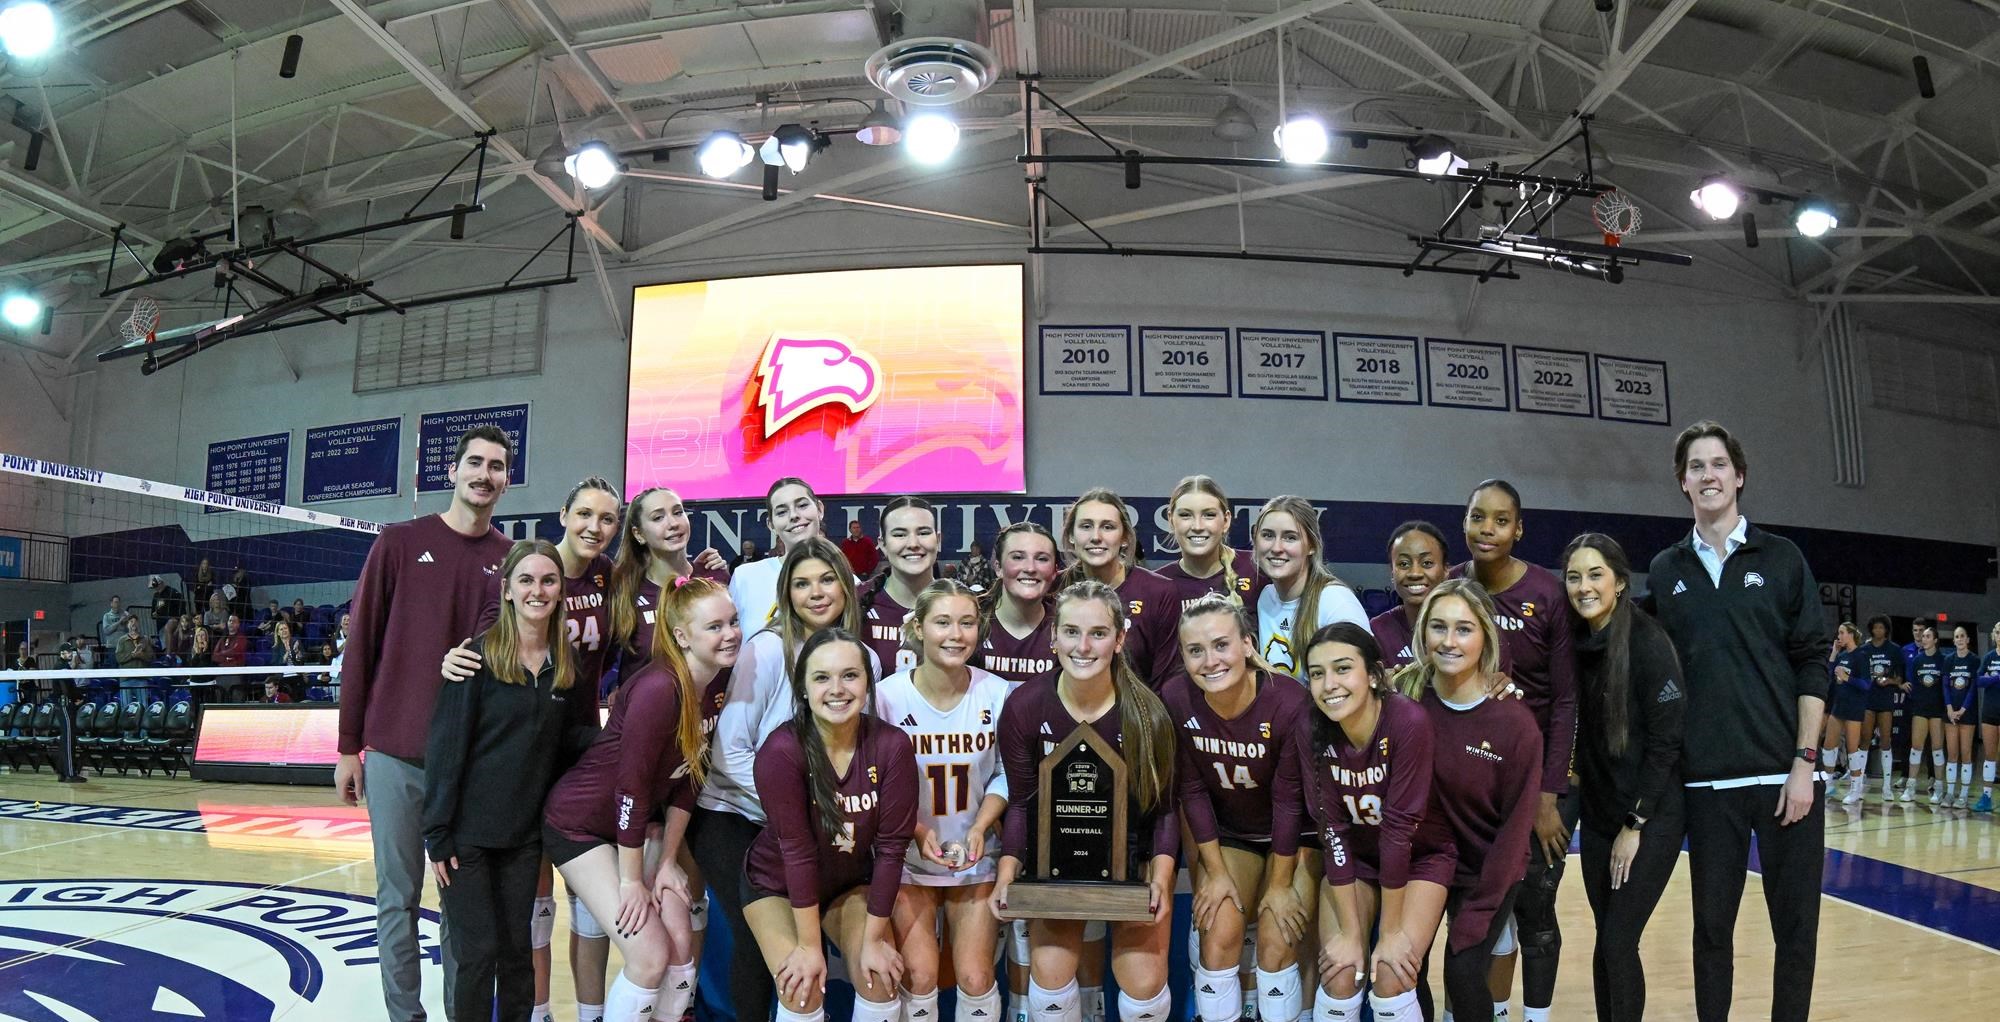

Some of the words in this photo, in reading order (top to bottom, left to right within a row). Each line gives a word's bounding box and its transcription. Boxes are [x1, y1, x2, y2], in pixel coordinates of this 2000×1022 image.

[1063, 349, 1109, 363] 2010
[1162, 351, 1209, 365] 2016
[1260, 353, 1305, 368] 2017
[1357, 358, 1400, 373] 2018
[1447, 363, 1488, 379] 2020
[1534, 370, 1573, 386] 2022
[1616, 379, 1652, 395] 2023
[474, 409, 525, 420] UNIVERSITY
[328, 429, 351, 437] POINT
[353, 423, 398, 434] UNIVERSITY
[227, 444, 246, 452] POINT
[248, 437, 287, 448] UNIVERSITY
[328, 435, 376, 445] VOLLEYBALL
[227, 449, 268, 460] VOLLEYBALL
[2, 454, 38, 472] POINT
[41, 460, 104, 483] UNIVERSITY
[184, 488, 204, 502] HIGH
[208, 492, 234, 506] POINT
[236, 497, 281, 514] UNIVERSITY
[307, 491, 343, 500] CONFERENCE
[345, 487, 391, 497] CHAMPIONSHIPS
[340, 516, 355, 528] HIGH
[357, 520, 376, 531] POINT
[565, 592, 603, 612] THROP
[566, 616, 601, 652] 24
[984, 655, 1054, 674] WINTHROP
[1192, 736, 1266, 758] WINTHROP
[1466, 745, 1502, 763] WINTHROP
[1212, 762, 1258, 790] 14
[926, 763, 970, 816] 11
[1056, 805, 1107, 814] RUNNER-UP
[1342, 794, 1383, 826] 13
[832, 822, 856, 854] 4
